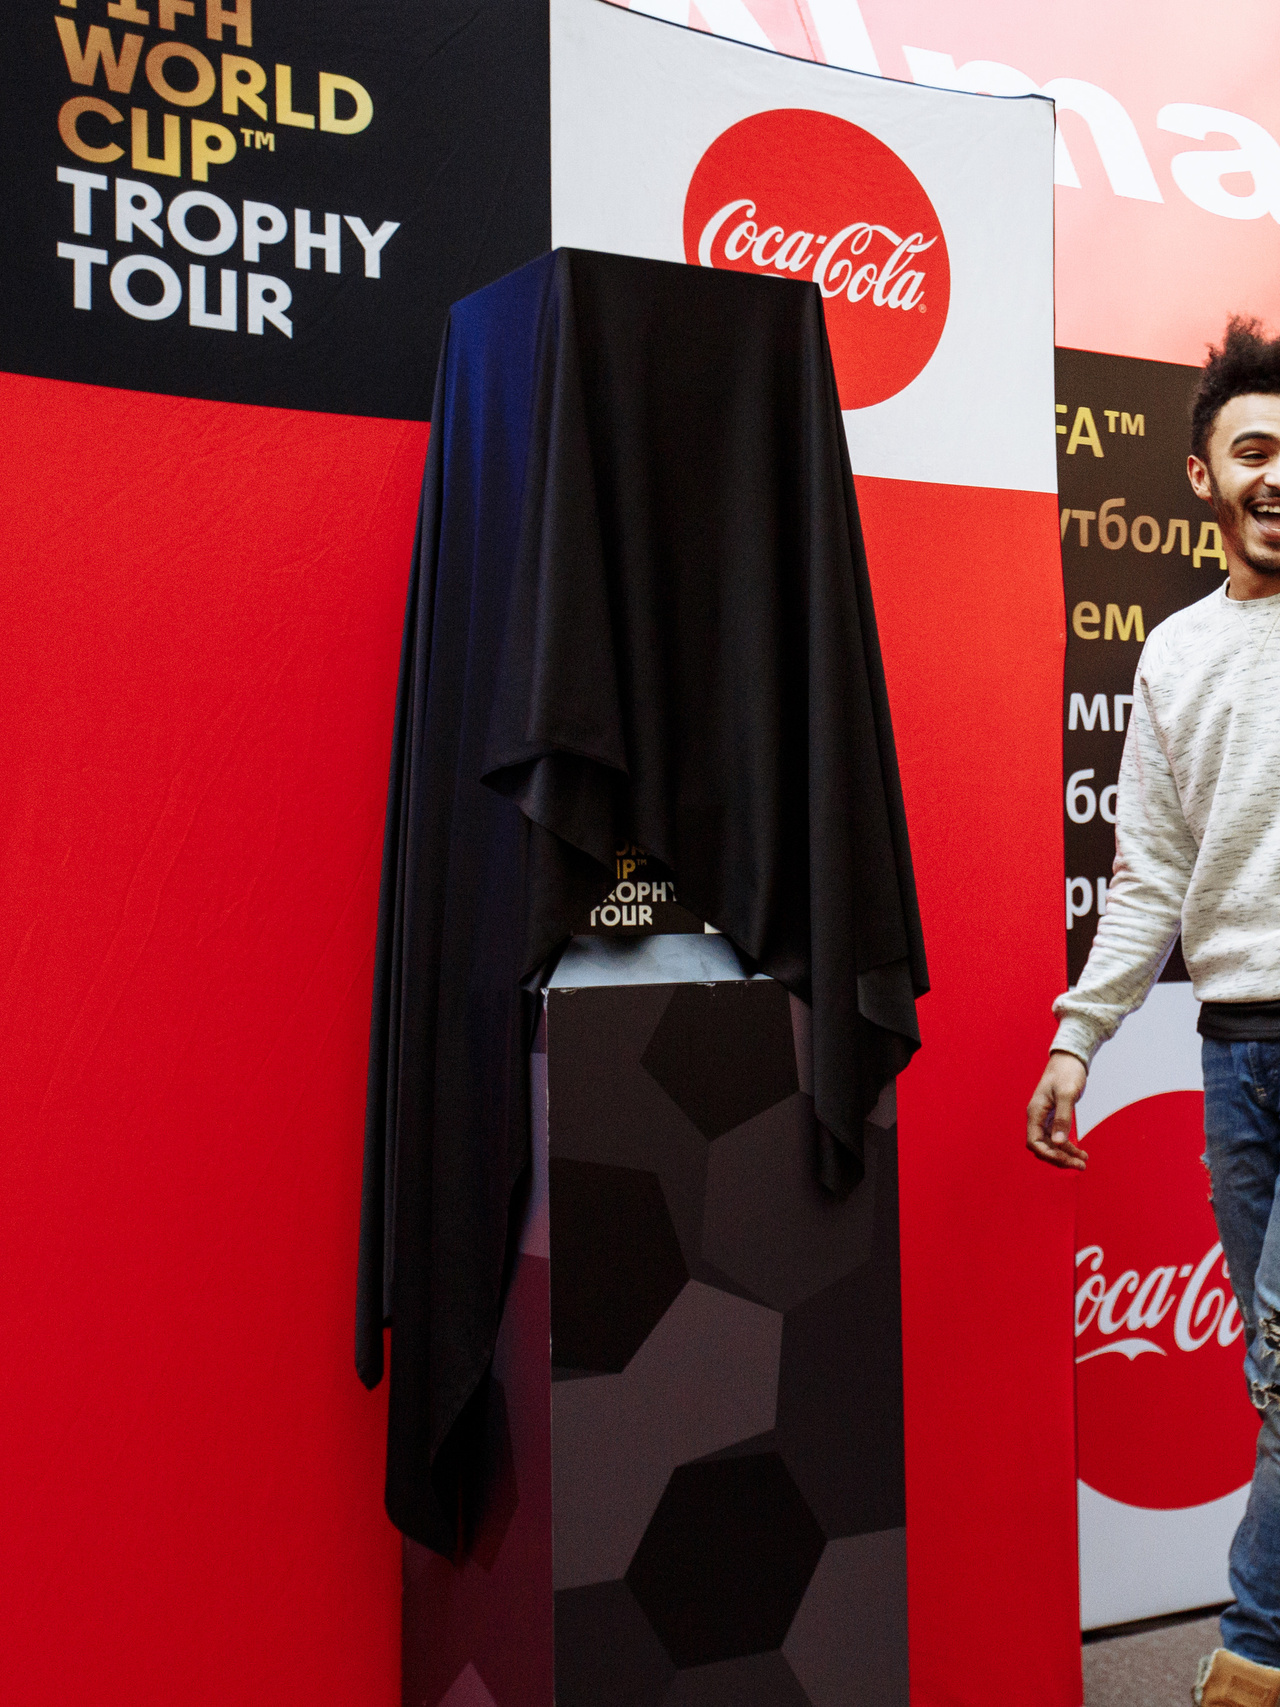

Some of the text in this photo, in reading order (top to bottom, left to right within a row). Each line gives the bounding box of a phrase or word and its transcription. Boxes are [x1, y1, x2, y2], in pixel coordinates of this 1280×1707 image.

[54, 16, 373, 135] WORLD
[57, 96, 276, 182] CUP™
[56, 165, 401, 279] TROPHY
[56, 241, 293, 339] TOUR
[590, 904, 653, 926] TOUR
